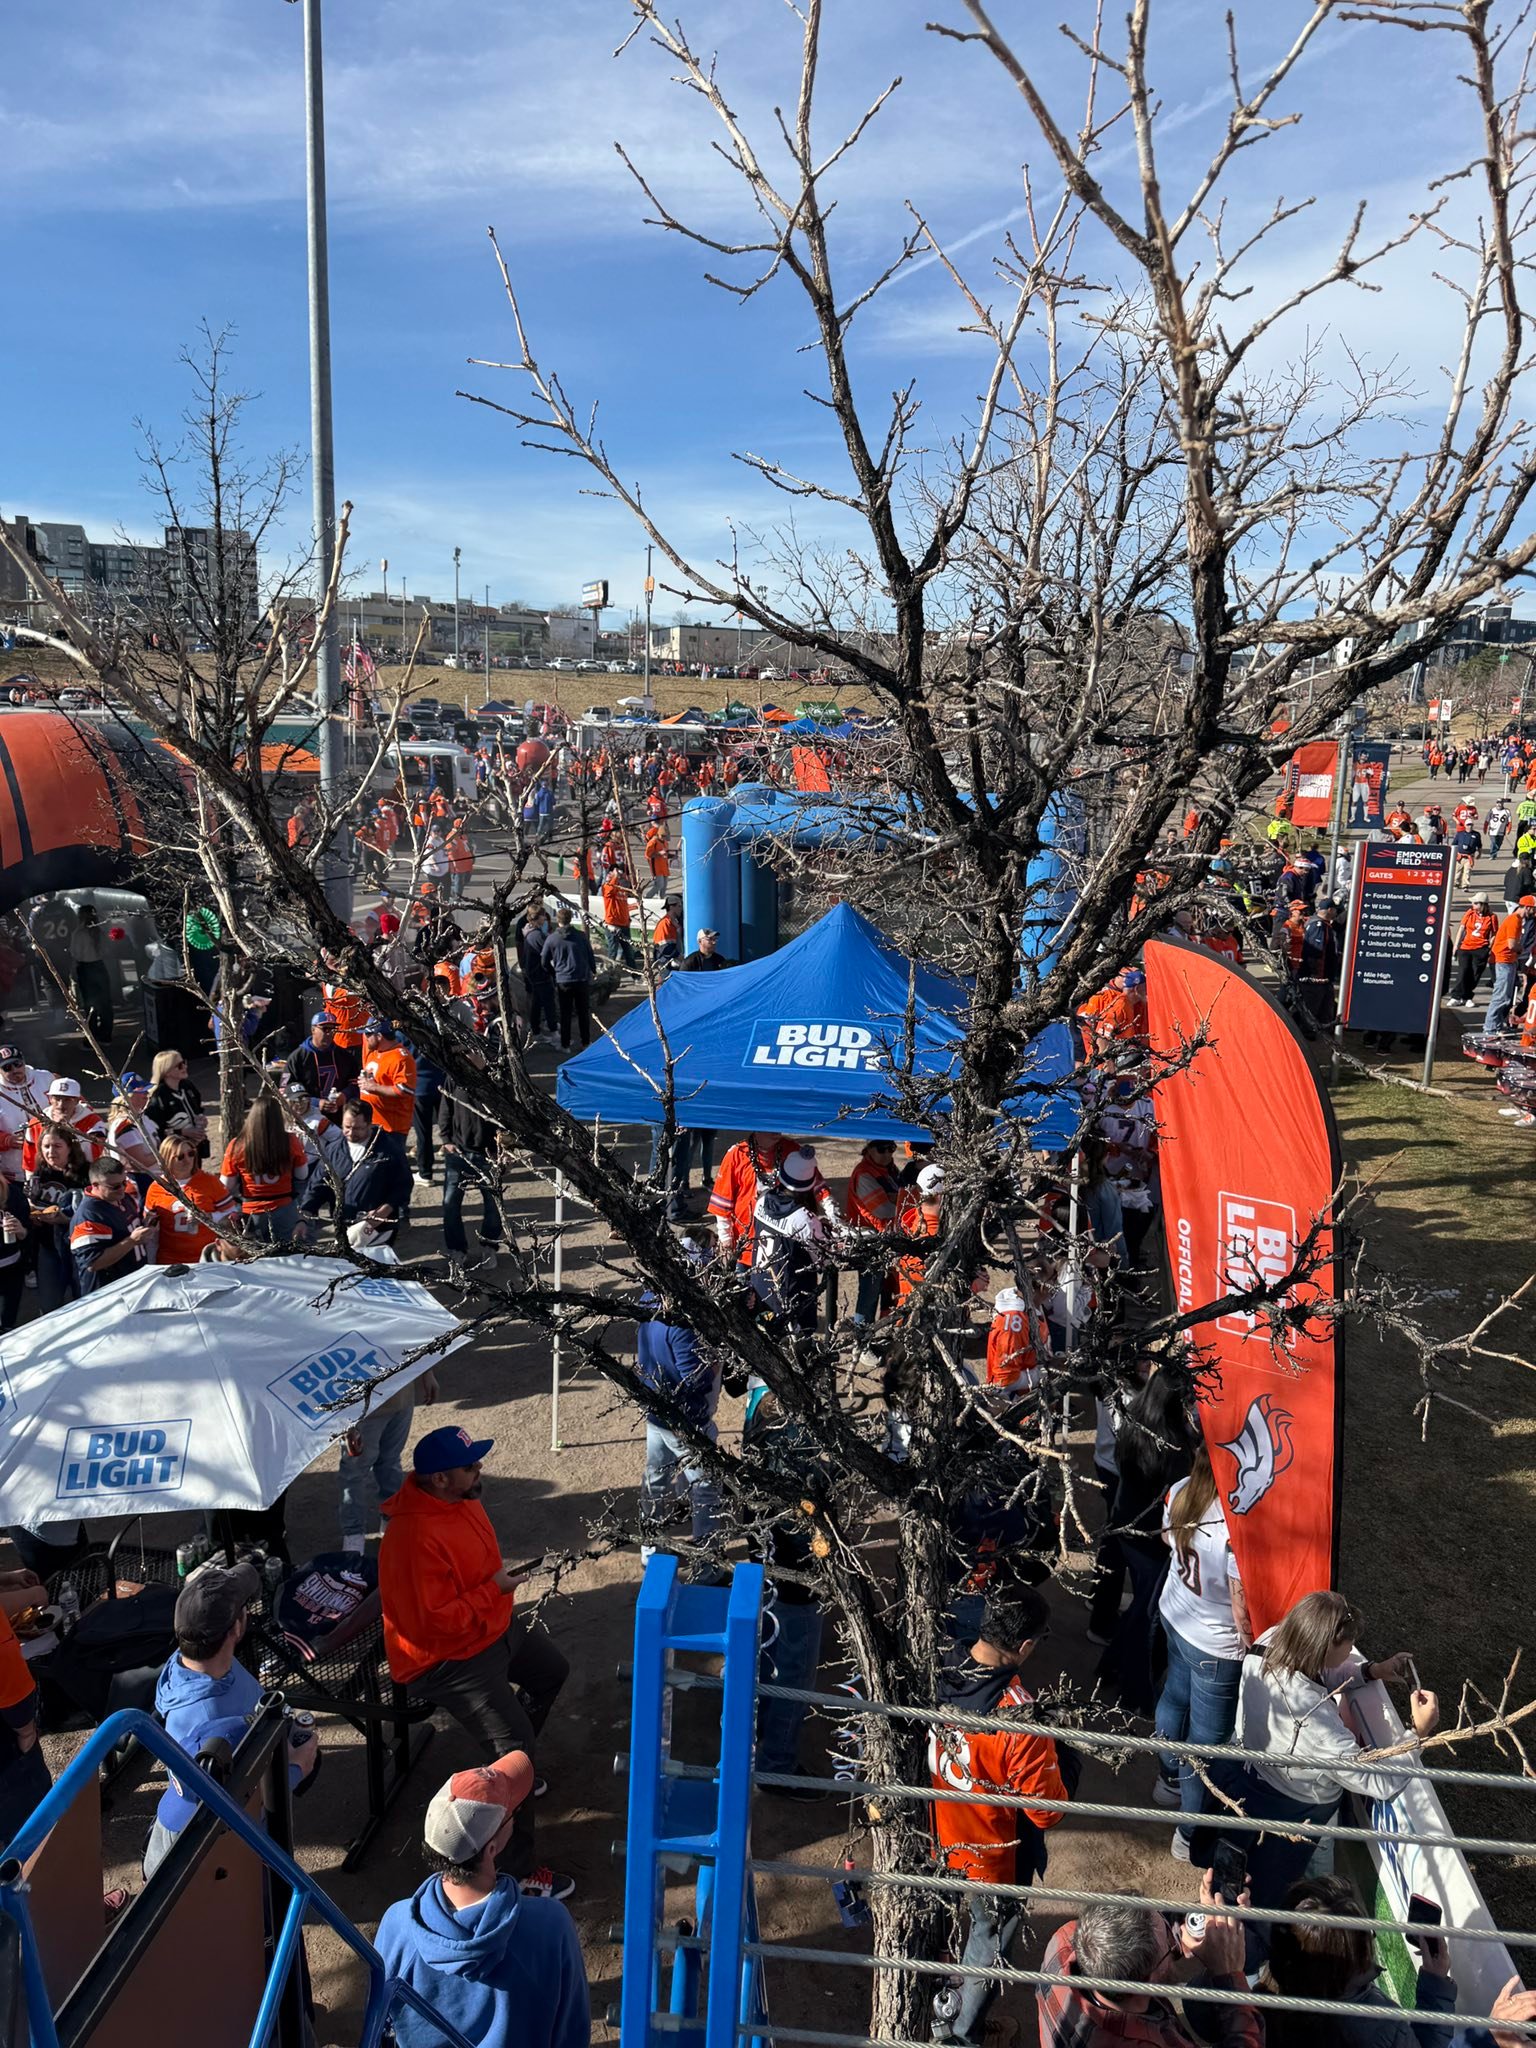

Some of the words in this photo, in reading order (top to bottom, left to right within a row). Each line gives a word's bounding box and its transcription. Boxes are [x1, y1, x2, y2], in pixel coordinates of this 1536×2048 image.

[1492, 813, 1507, 824] 56
[1395, 858, 1421, 866] FIELD
[1396, 850, 1443, 860] EMPOWER
[1369, 871, 1393, 880] GATES
[1471, 922, 1483, 937] 2
[776, 1024, 872, 1049] BUD
[752, 1045, 884, 1070] LIGHT
[1177, 1218, 1193, 1308] OFFICIAL
[1003, 1313, 1023, 1333] 18
[288, 1347, 357, 1395] BUD
[296, 1349, 383, 1421] LIGHT
[86, 1429, 167, 1460] BUD
[65, 1455, 178, 1490] LIGHT
